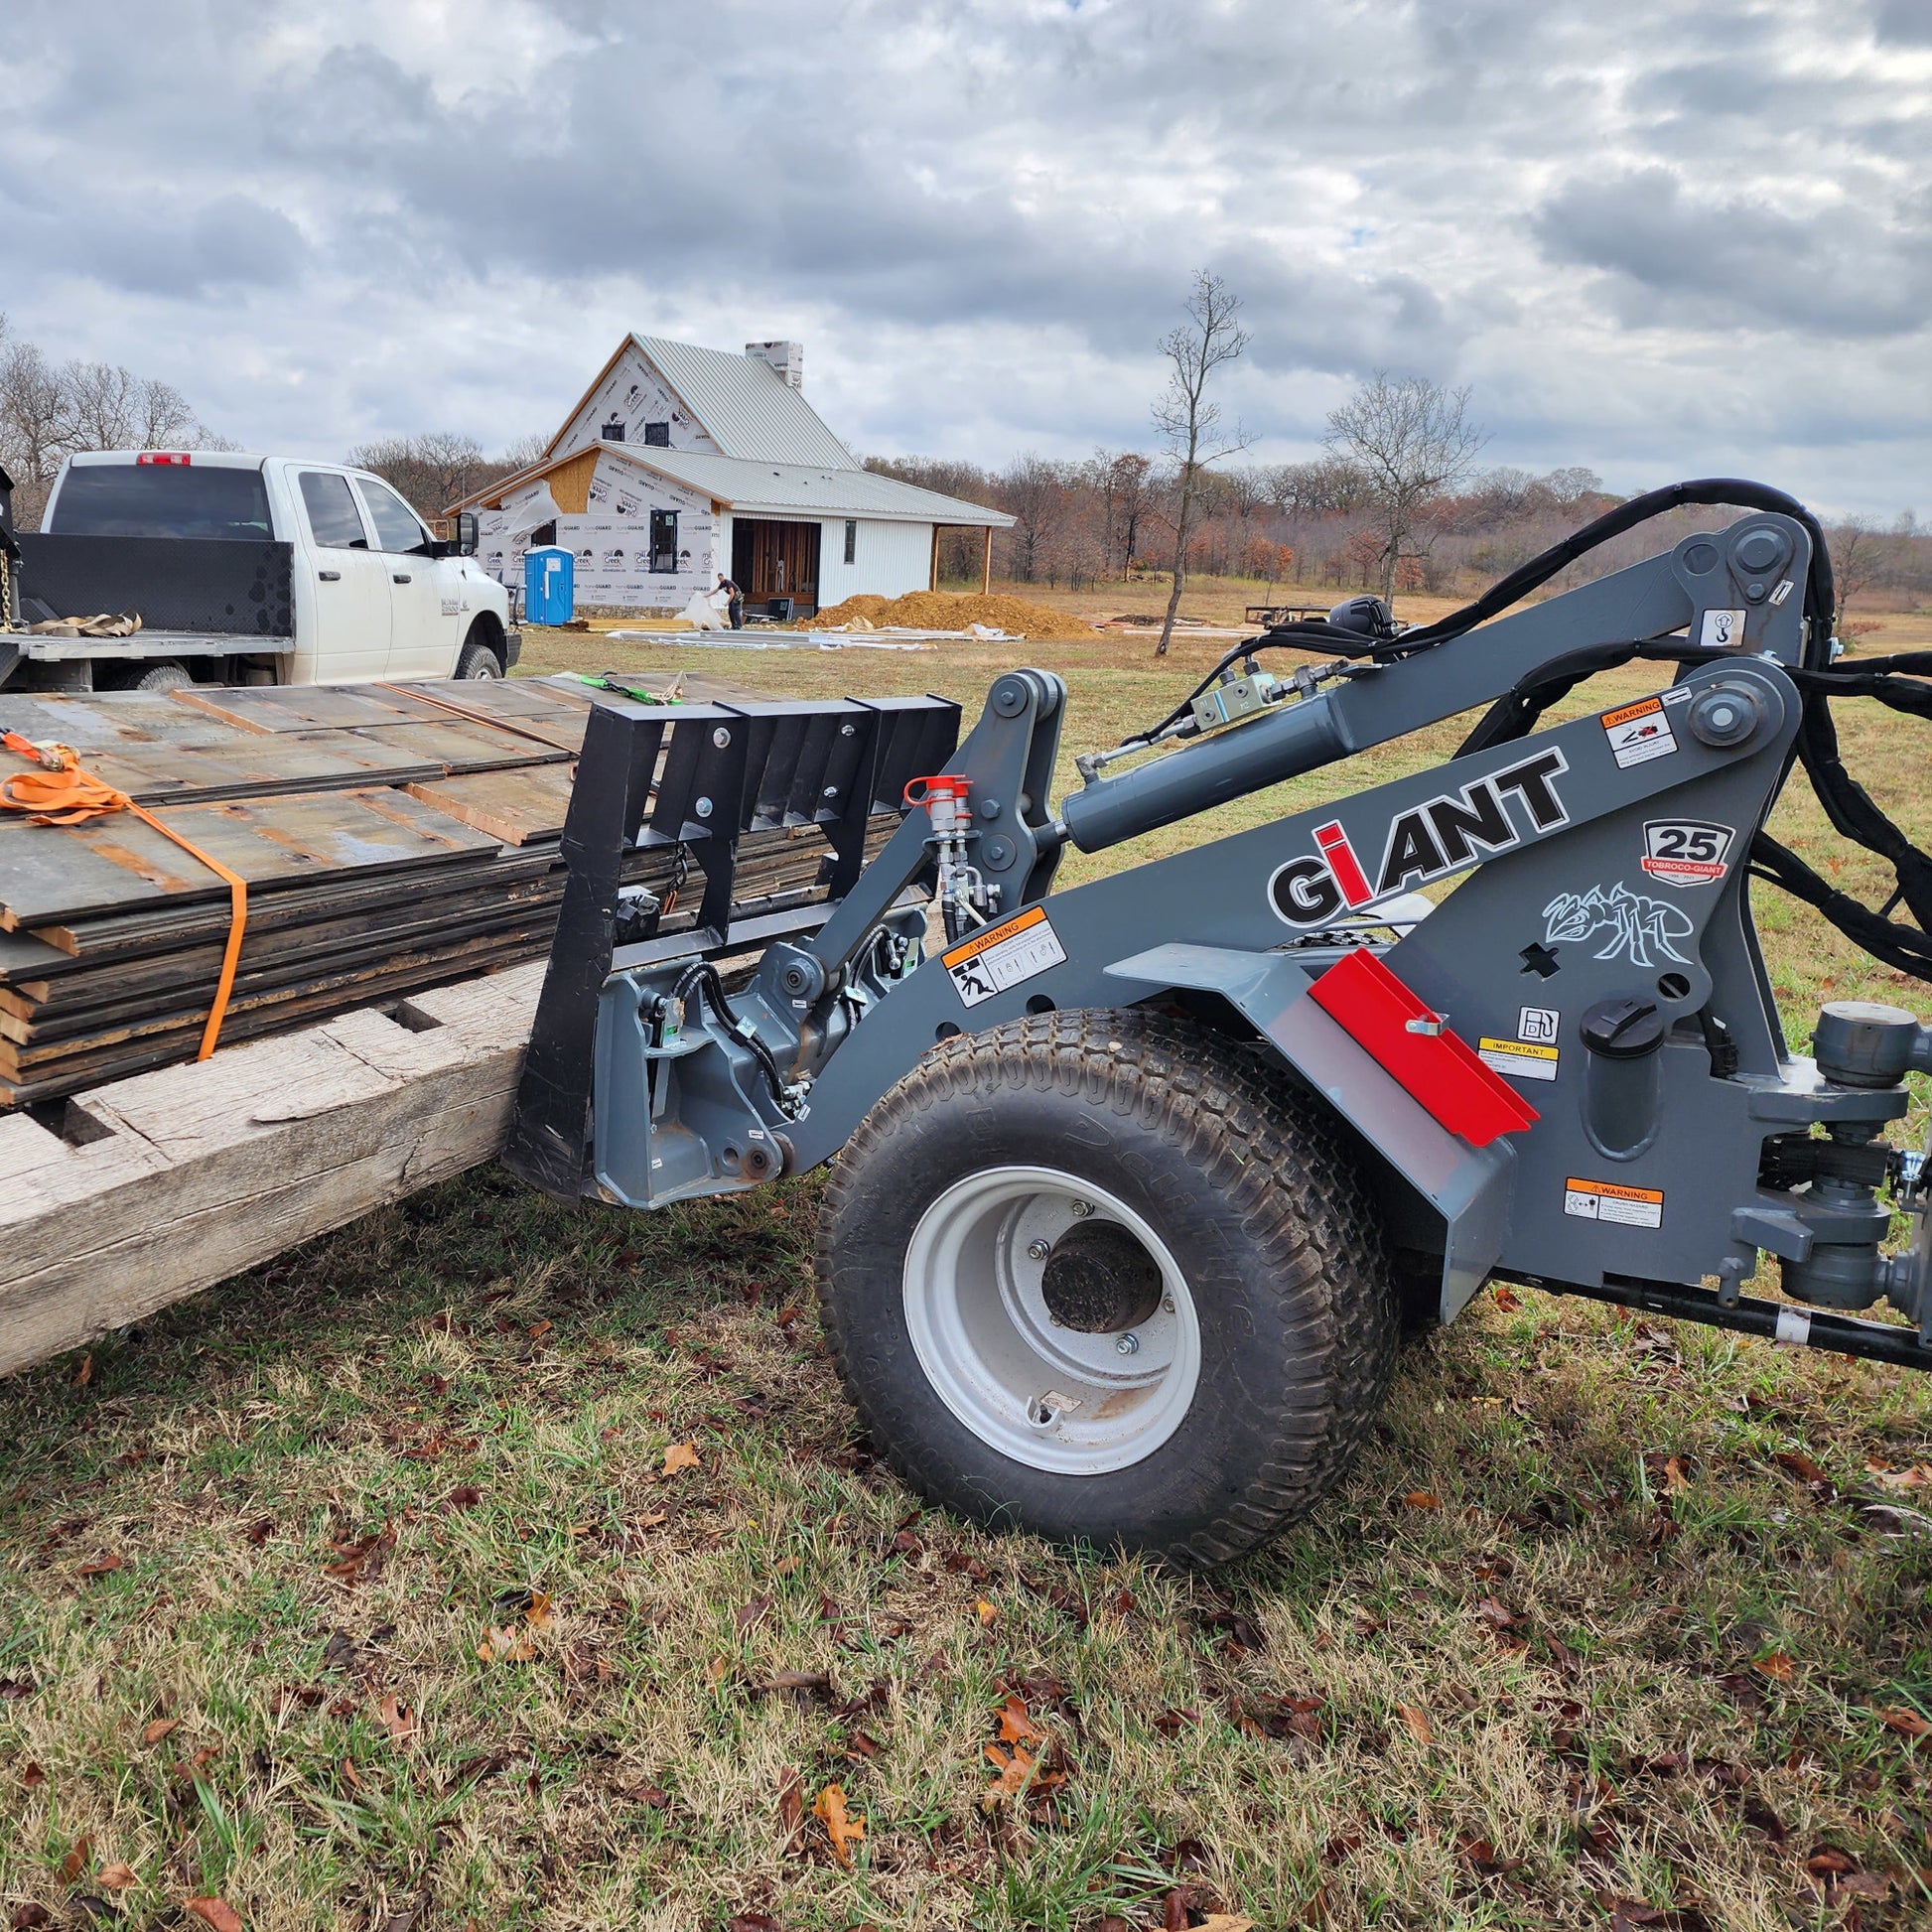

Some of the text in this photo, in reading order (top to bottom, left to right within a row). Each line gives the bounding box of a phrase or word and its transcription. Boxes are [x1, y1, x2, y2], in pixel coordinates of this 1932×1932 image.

[1613, 701, 1660, 722] WARNING
[1656, 829, 1718, 862] 25
[1646, 861, 1722, 874] TOBROCO-GIANT
[975, 922, 1020, 949] WARNING
[1493, 1043, 1545, 1055] IMPORTANT
[1601, 1187, 1648, 1200] WARNING
